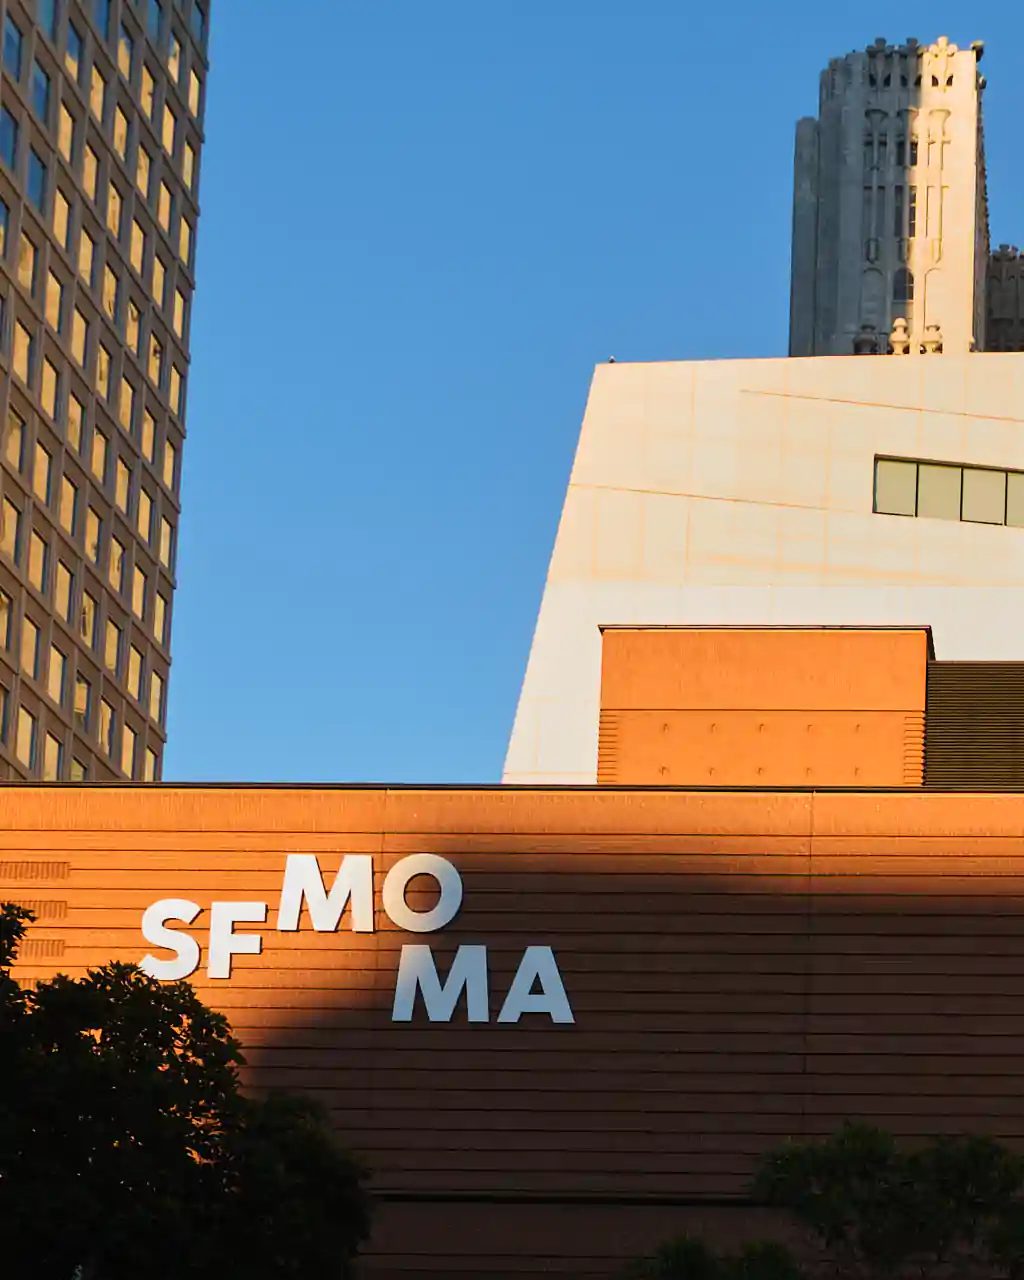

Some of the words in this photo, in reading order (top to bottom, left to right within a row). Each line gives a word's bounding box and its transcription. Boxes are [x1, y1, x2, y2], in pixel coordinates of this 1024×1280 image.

[138, 898, 268, 981] SF
[277, 853, 463, 933] MO
[391, 944, 576, 1024] MA
